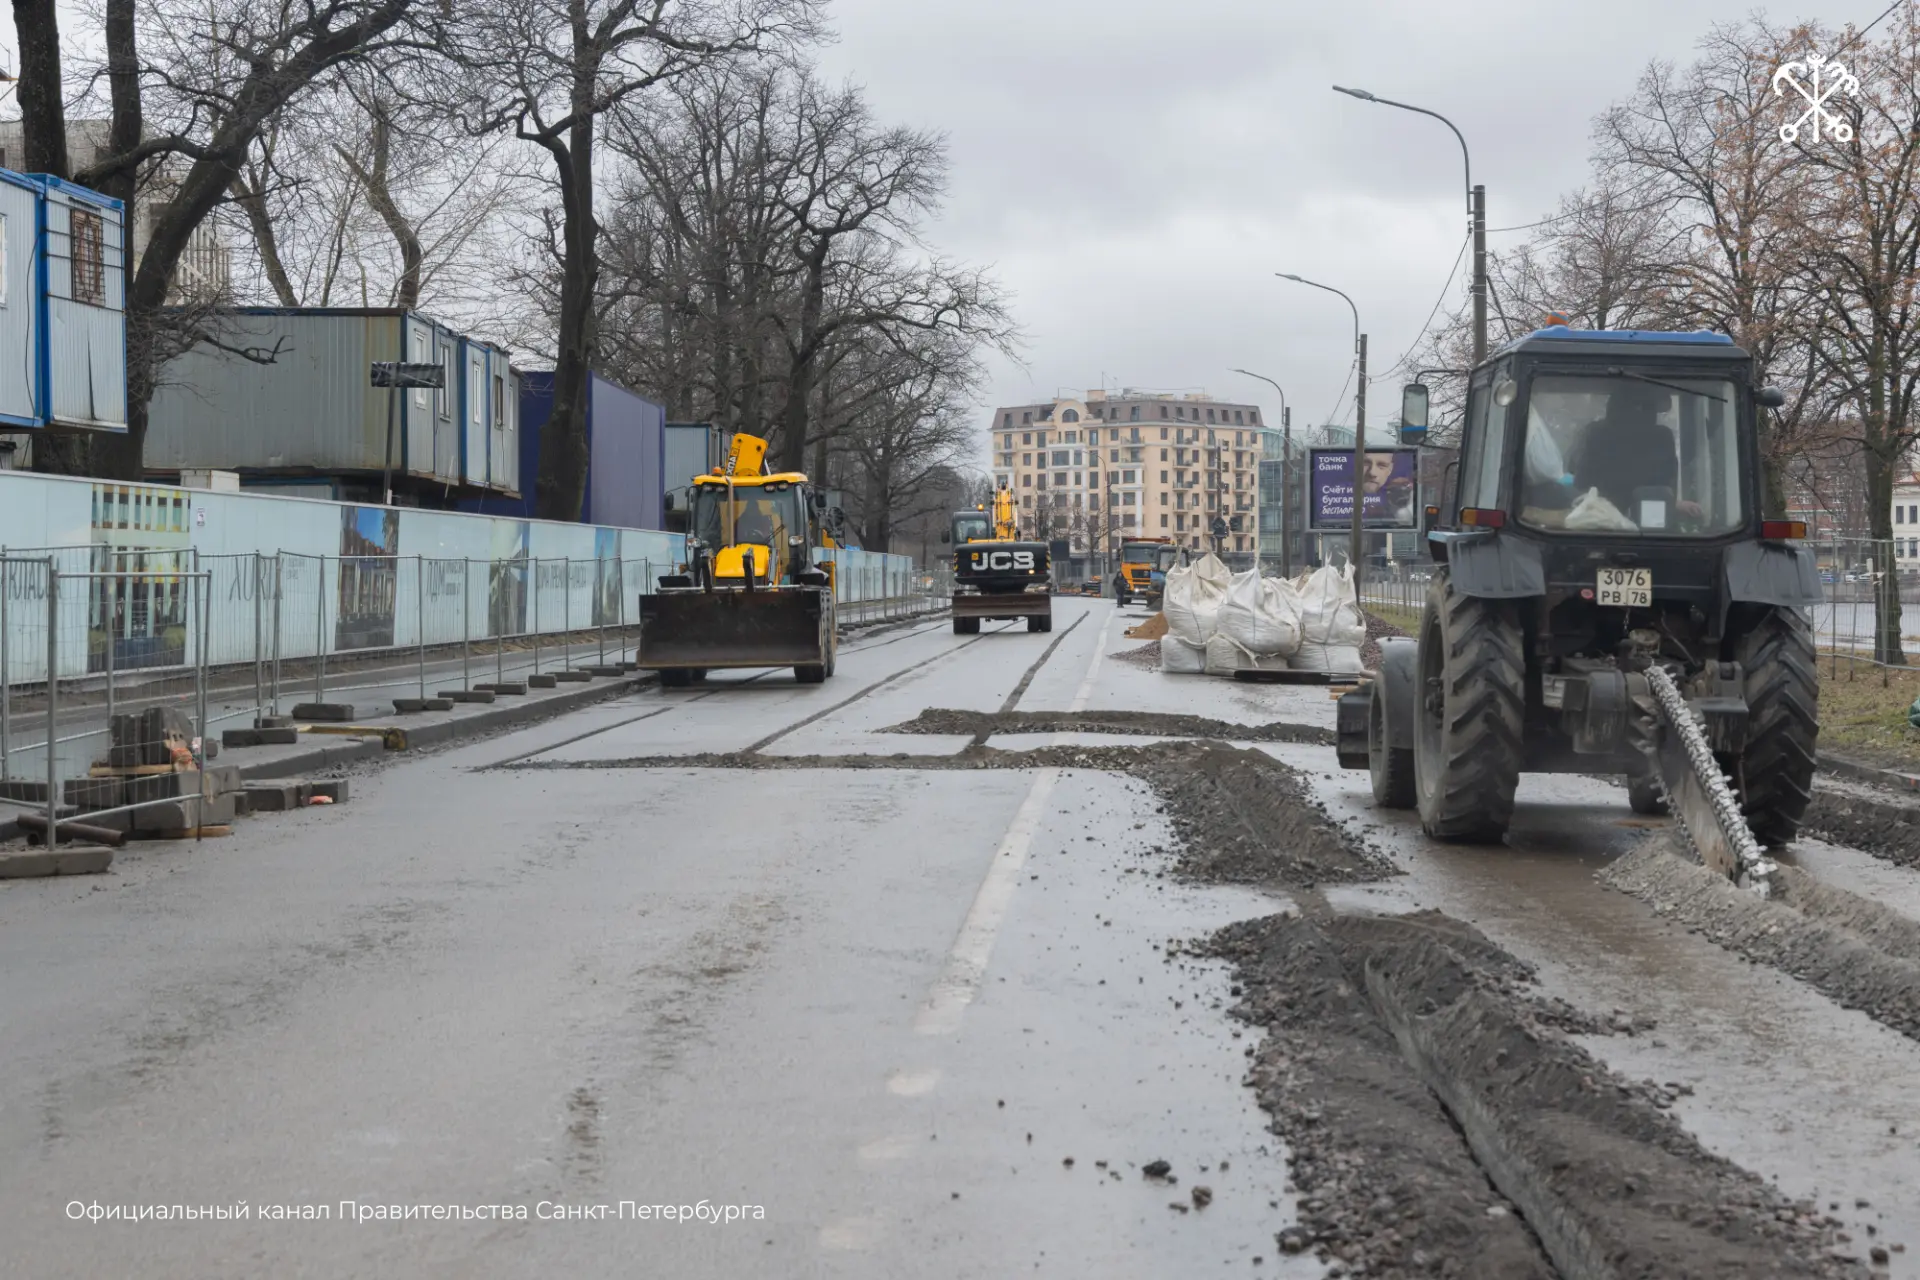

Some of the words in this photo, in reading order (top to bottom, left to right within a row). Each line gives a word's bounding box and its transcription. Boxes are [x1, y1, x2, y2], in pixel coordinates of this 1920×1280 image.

[1319, 462, 1342, 471] банк
[1322, 485, 1346, 494] Счёт
[1322, 495, 1381, 505] бухгалрия
[1321, 505, 1366, 515] бесплато
[971, 551, 1035, 571] JCB
[1604, 570, 1645, 586] 3076
[1631, 591, 1648, 605] 78
